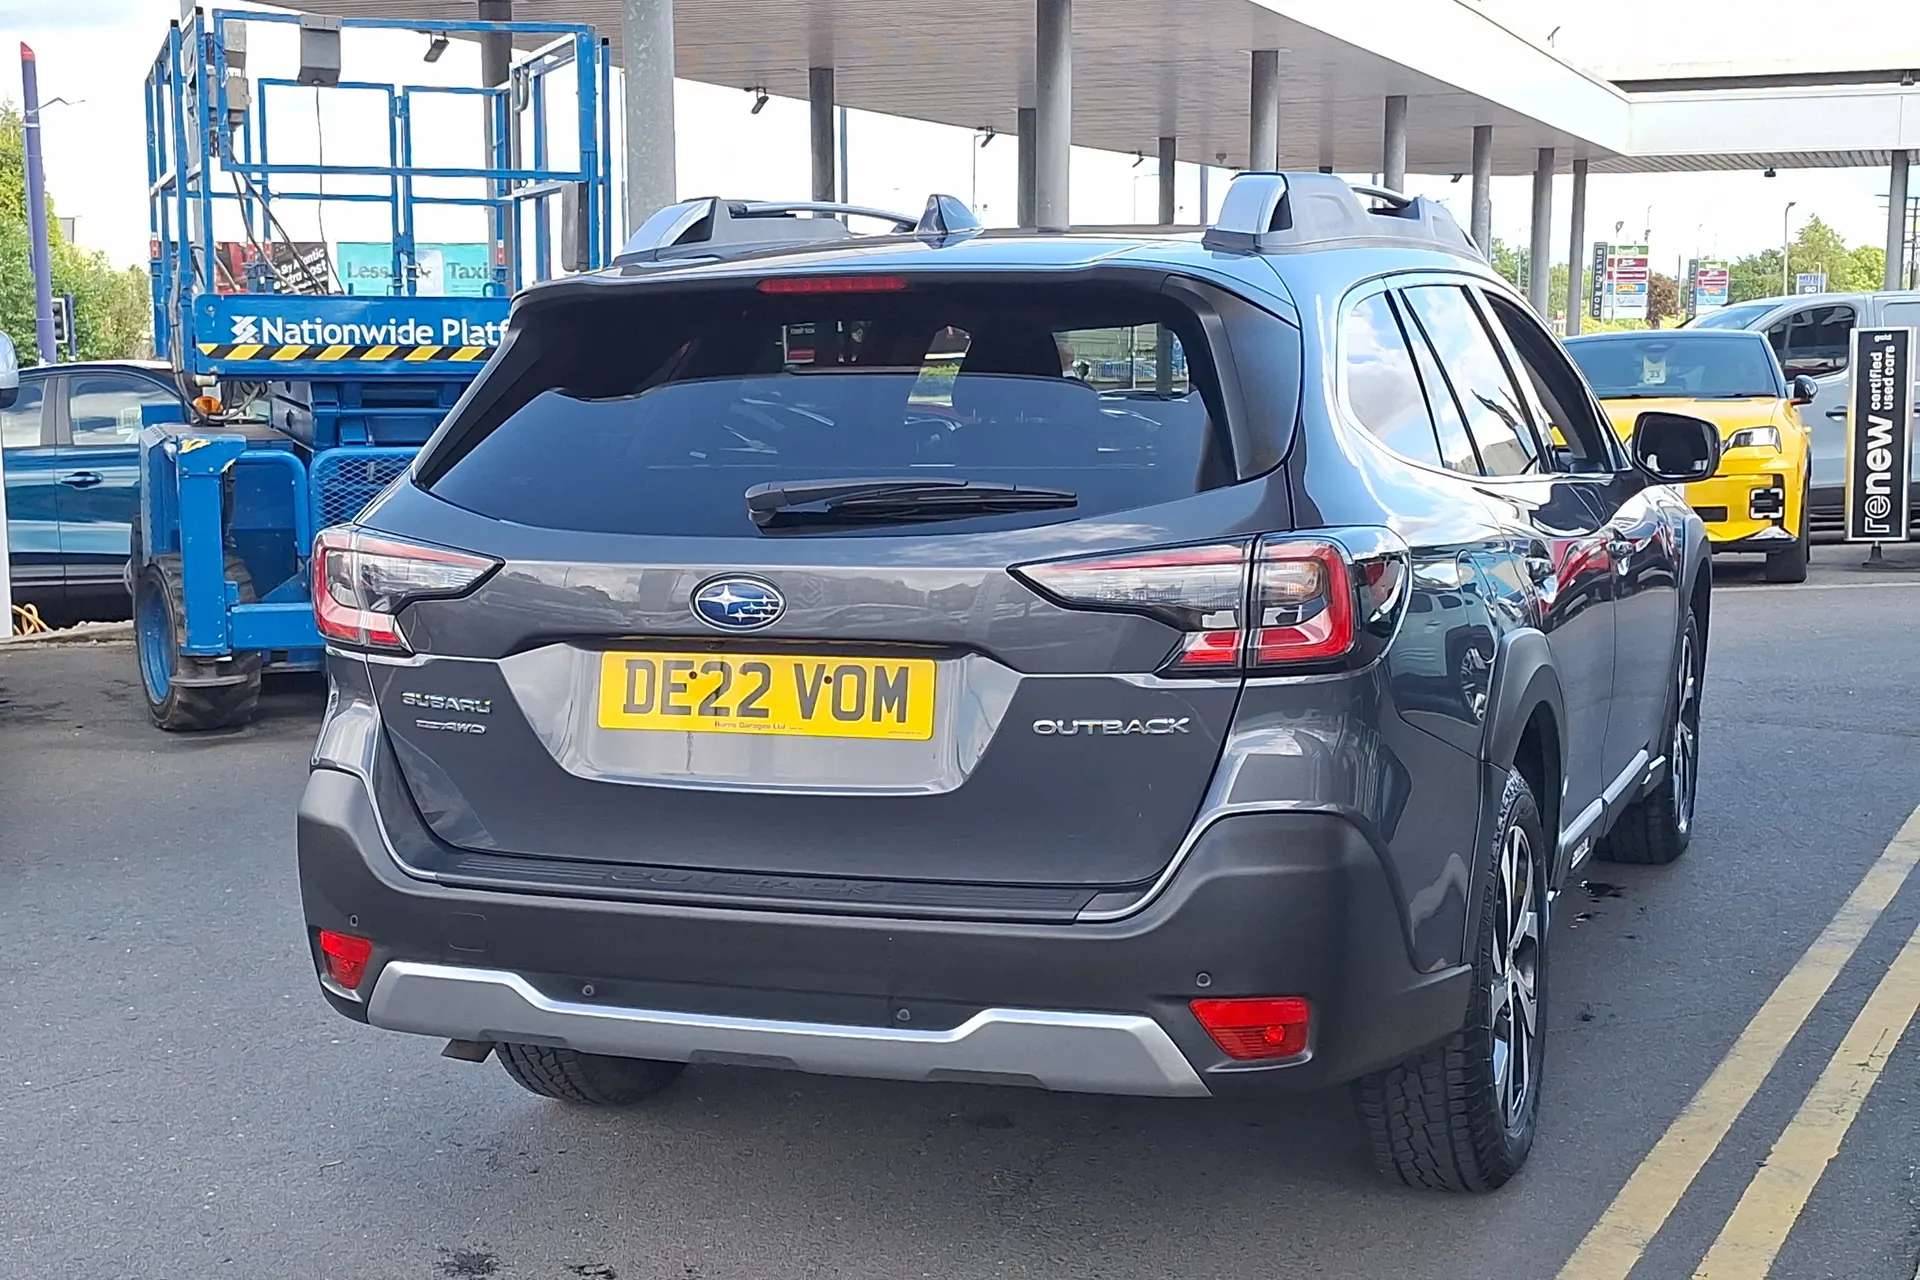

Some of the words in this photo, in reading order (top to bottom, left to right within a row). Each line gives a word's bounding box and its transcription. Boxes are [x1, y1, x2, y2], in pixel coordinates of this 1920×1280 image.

[293, 248, 325, 270] Aantic
[347, 262, 391, 279] Less
[1593, 290, 1602, 316] ROAD
[262, 317, 434, 345] Nationwide
[442, 318, 510, 346] Platf
[1884, 345, 1896, 376] cars
[1869, 351, 1883, 411] certified
[1882, 377, 1895, 411] used
[402, 692, 491, 714] SUBARU
[622, 658, 772, 719] DE22
[793, 662, 910, 724] VOM
[441, 721, 487, 734] AWD
[1032, 717, 1190, 736] OUTBACK
